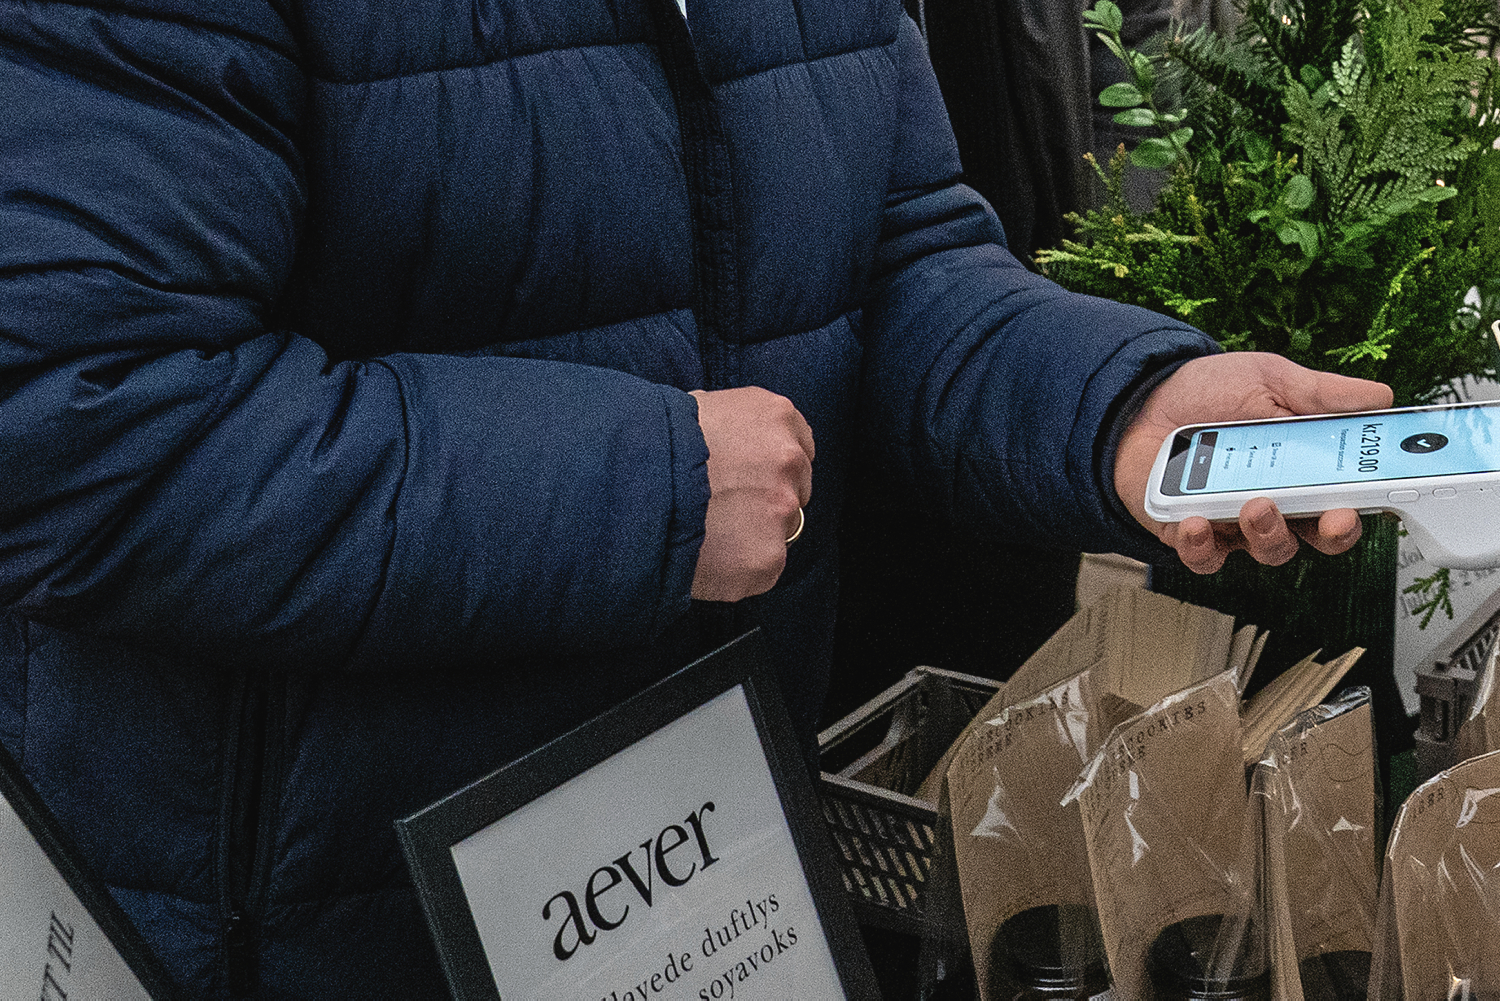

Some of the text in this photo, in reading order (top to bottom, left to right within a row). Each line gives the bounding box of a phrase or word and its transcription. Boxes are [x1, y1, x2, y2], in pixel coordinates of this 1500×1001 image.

[1357, 422, 1384, 474] kr.219.00
[541, 800, 720, 962] aever
[47, 909, 75, 974] TIL
[602, 892, 780, 1001] avede duftlys
[698, 926, 799, 1001] soyavoks
